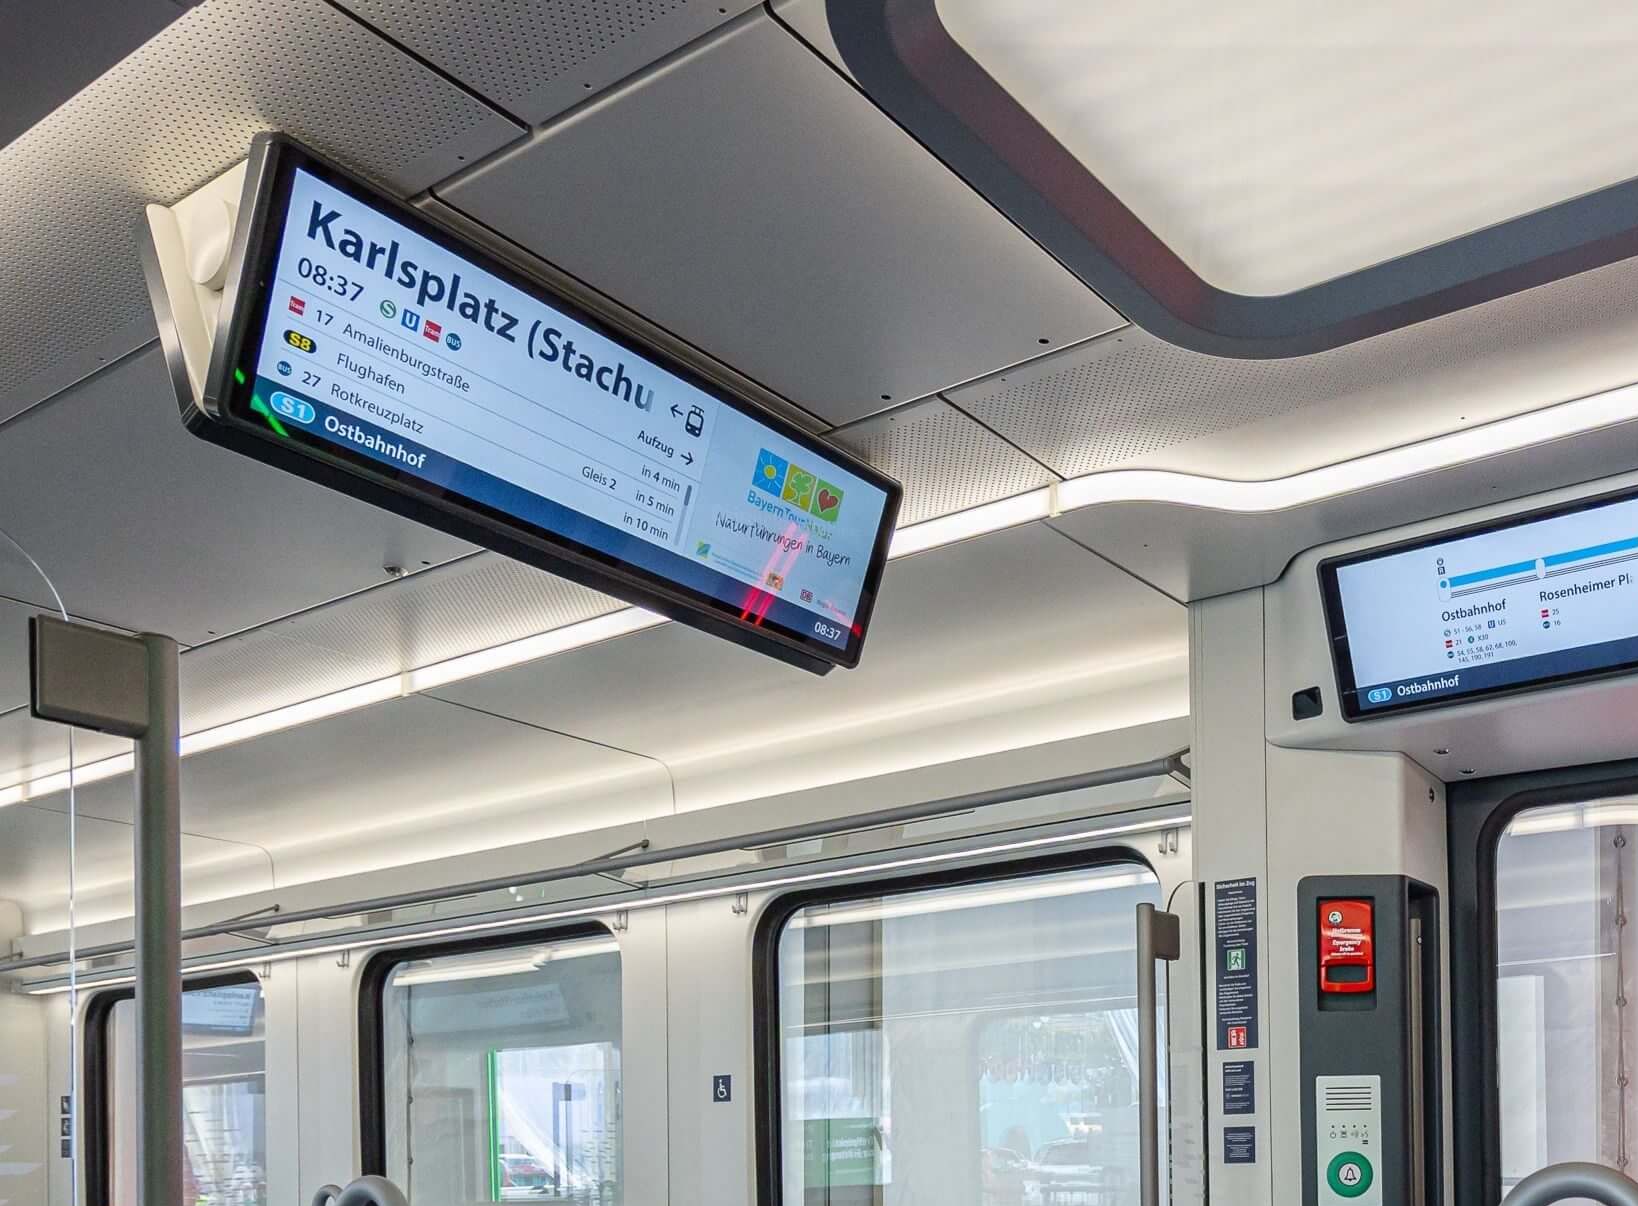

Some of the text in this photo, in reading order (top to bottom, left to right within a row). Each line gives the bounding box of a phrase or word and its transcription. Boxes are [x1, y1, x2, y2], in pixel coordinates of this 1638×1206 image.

[298, 257, 364, 302] 08:37
[446, 335, 461, 348] BUS
[307, 200, 655, 411] Karlsplatz (Stachu
[288, 332, 675, 517] S8 Flughafen Gleis 2 in 5 min
[316, 310, 333, 326] 17
[343, 324, 470, 392] Amalienburgstraße
[641, 464, 652, 478] in
[652, 471, 660, 483] 4
[661, 476, 680, 493] min
[281, 397, 426, 468] S1 Ostbahnhof
[302, 371, 321, 388] 27
[331, 384, 424, 434] Rotkreuzplatz
[623, 512, 633, 526] in
[635, 518, 648, 532] 10
[649, 525, 669, 541] min
[637, 430, 674, 458] Aufzug
[805, 540, 814, 554] in
[816, 544, 850, 568] Bayern
[1441, 598, 1506, 622] Ostbahnhof
[1539, 573, 1633, 602] Rosenheimer Pl
[814, 621, 841, 641] 08:37
[1397, 675, 1460, 697] Ostbahnhof
